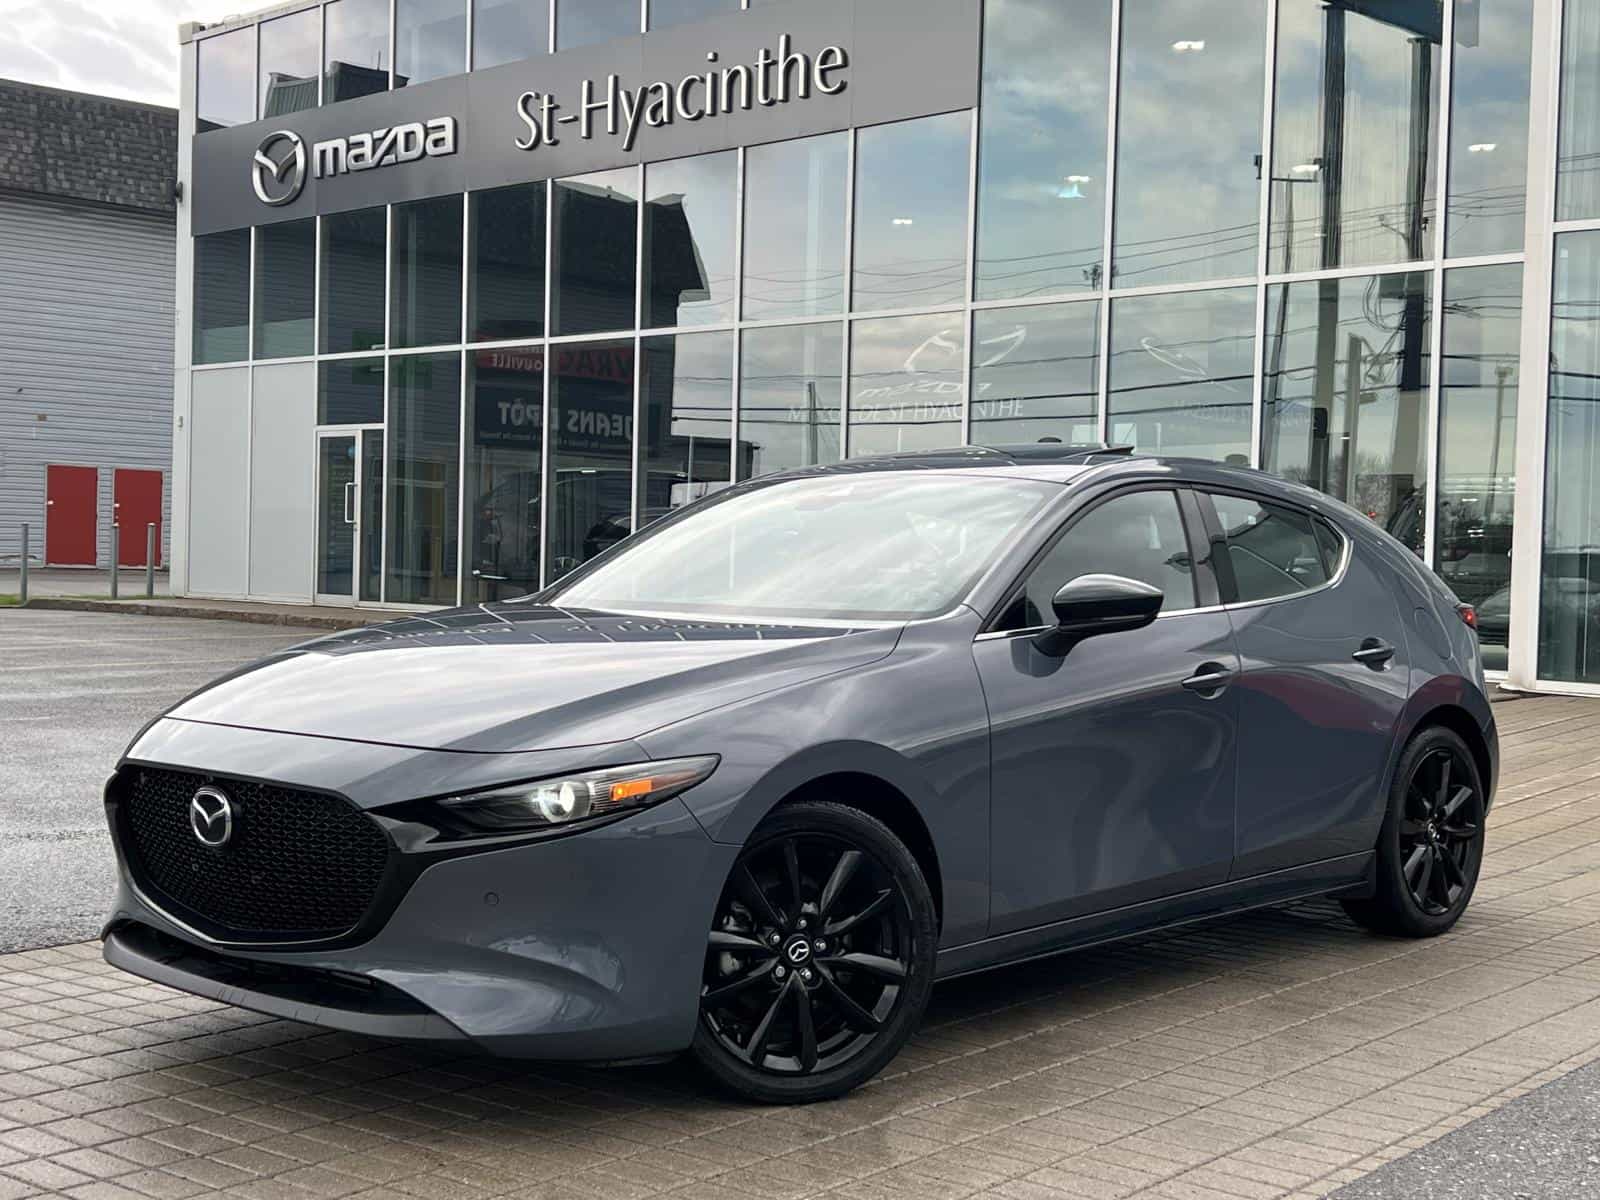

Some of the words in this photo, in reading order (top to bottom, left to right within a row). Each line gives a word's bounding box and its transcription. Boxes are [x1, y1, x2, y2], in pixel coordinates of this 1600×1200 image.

[514, 34, 849, 152] St-Hyacinthe
[312, 116, 457, 179] mazda
[887, 397, 1024, 422] ST-HYACNTHE
